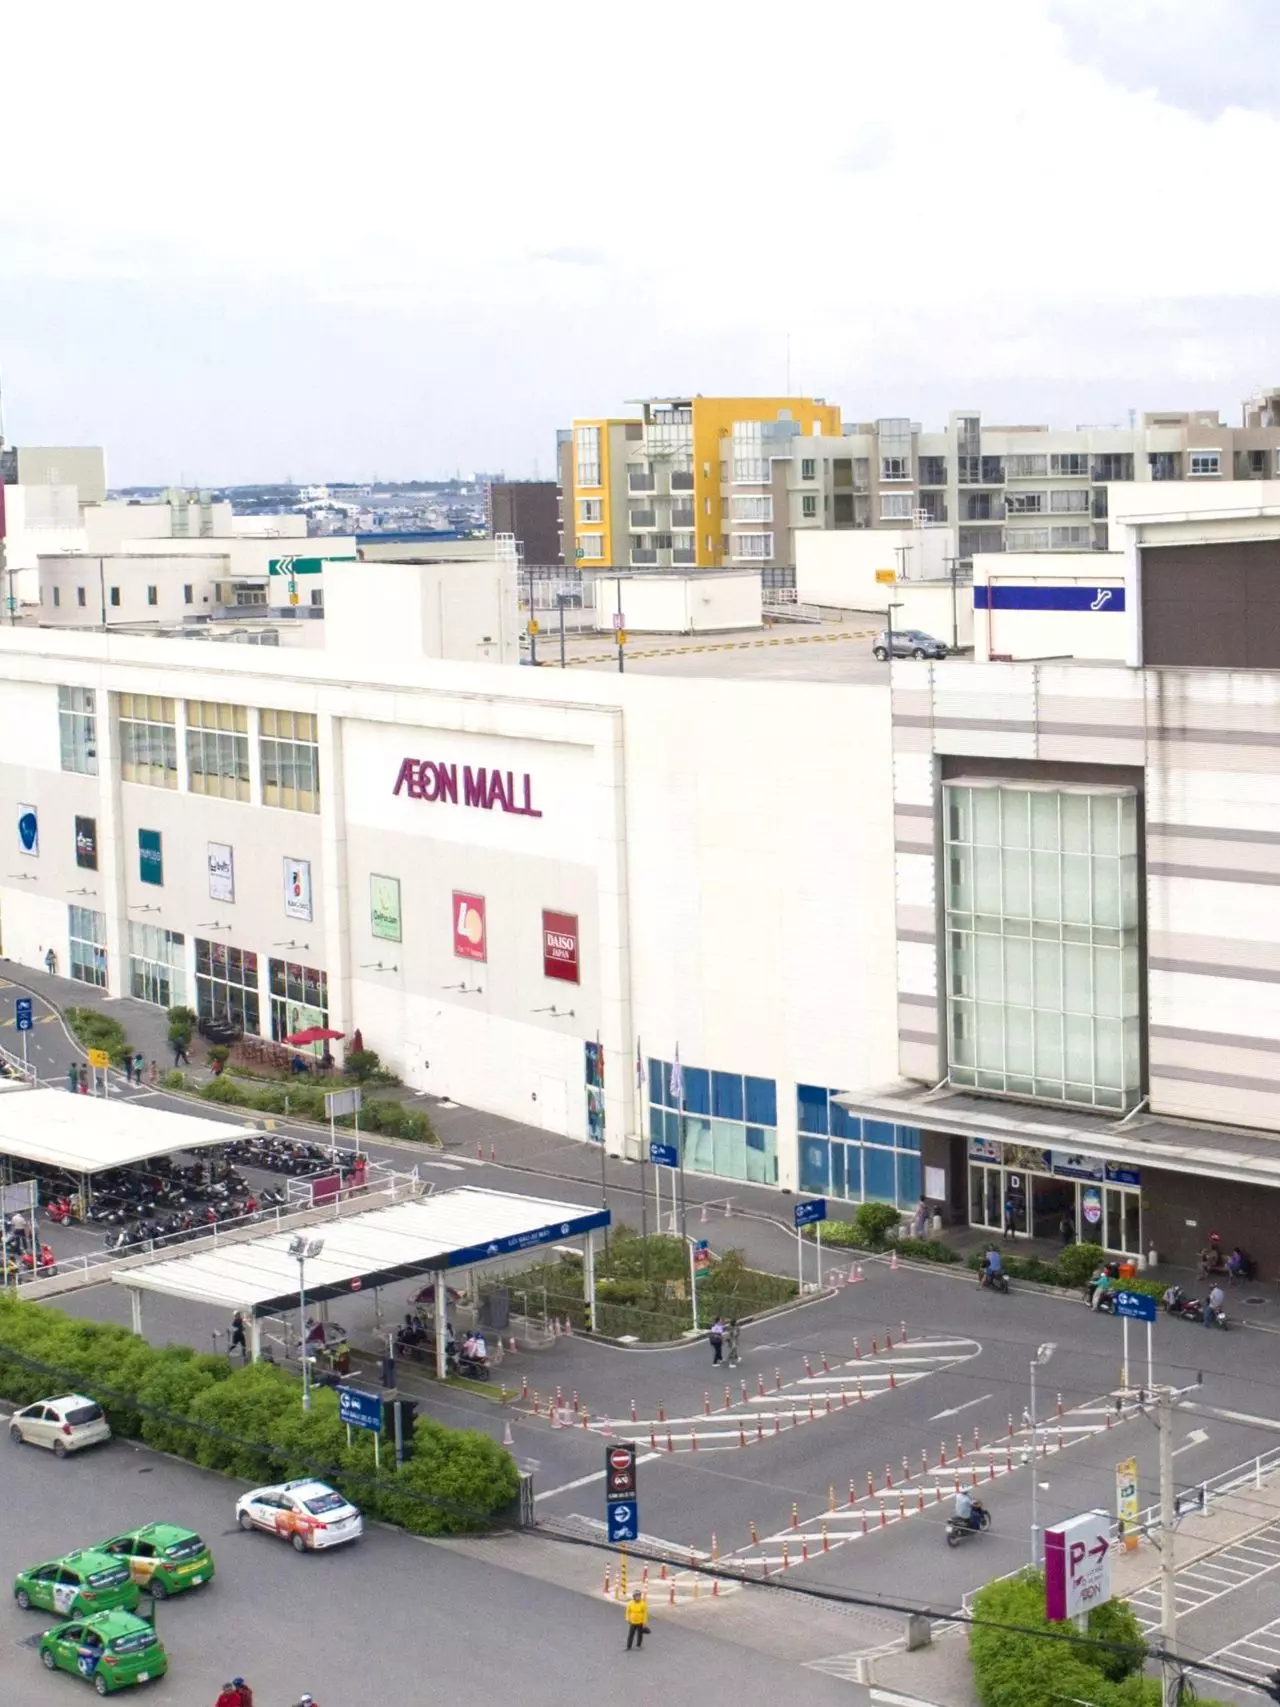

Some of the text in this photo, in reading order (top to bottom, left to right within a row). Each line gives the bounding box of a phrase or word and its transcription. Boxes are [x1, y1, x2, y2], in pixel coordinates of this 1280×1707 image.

[463, 765, 543, 818] MALL
[547, 933, 574, 951] DAISO
[1011, 1175, 1021, 1189] D
[1070, 1541, 1086, 1578] P
